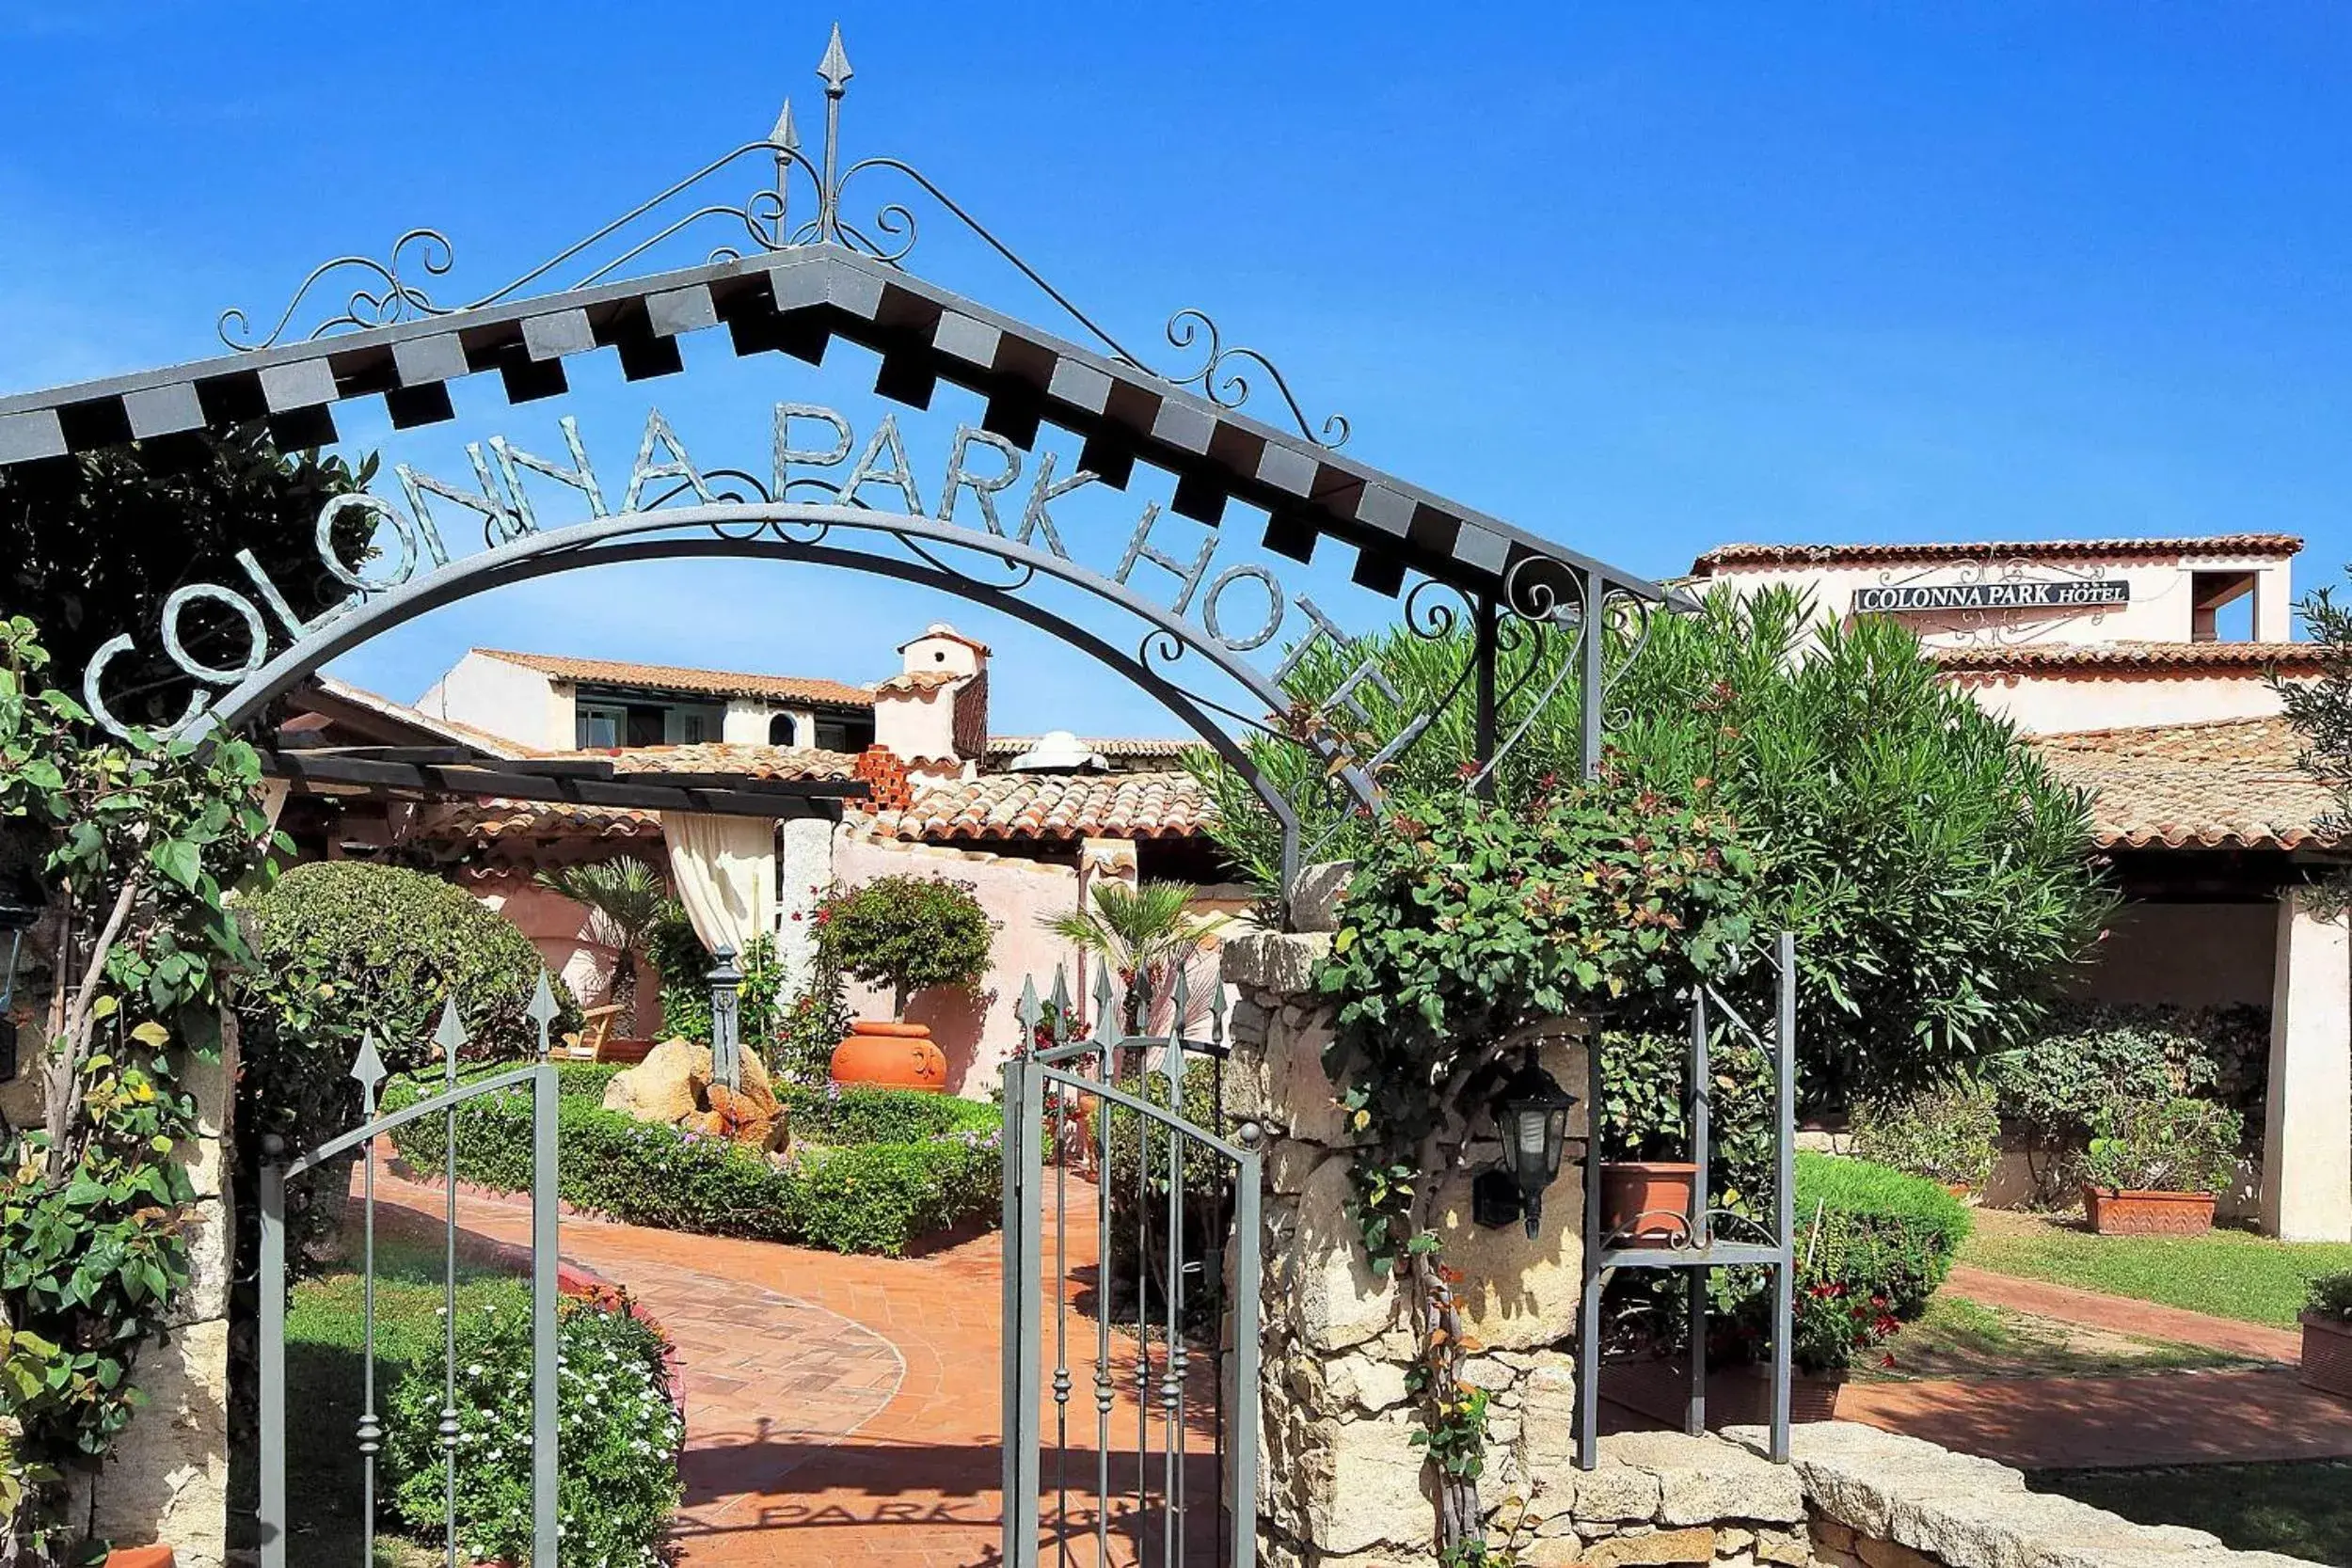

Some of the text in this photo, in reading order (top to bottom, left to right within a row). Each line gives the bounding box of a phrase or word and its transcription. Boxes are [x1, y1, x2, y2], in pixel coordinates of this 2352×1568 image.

[83, 401, 1431, 777] COLONNA PARK HOTEL
[1864, 583, 2126, 609] COLONNA PARK HOTEL
